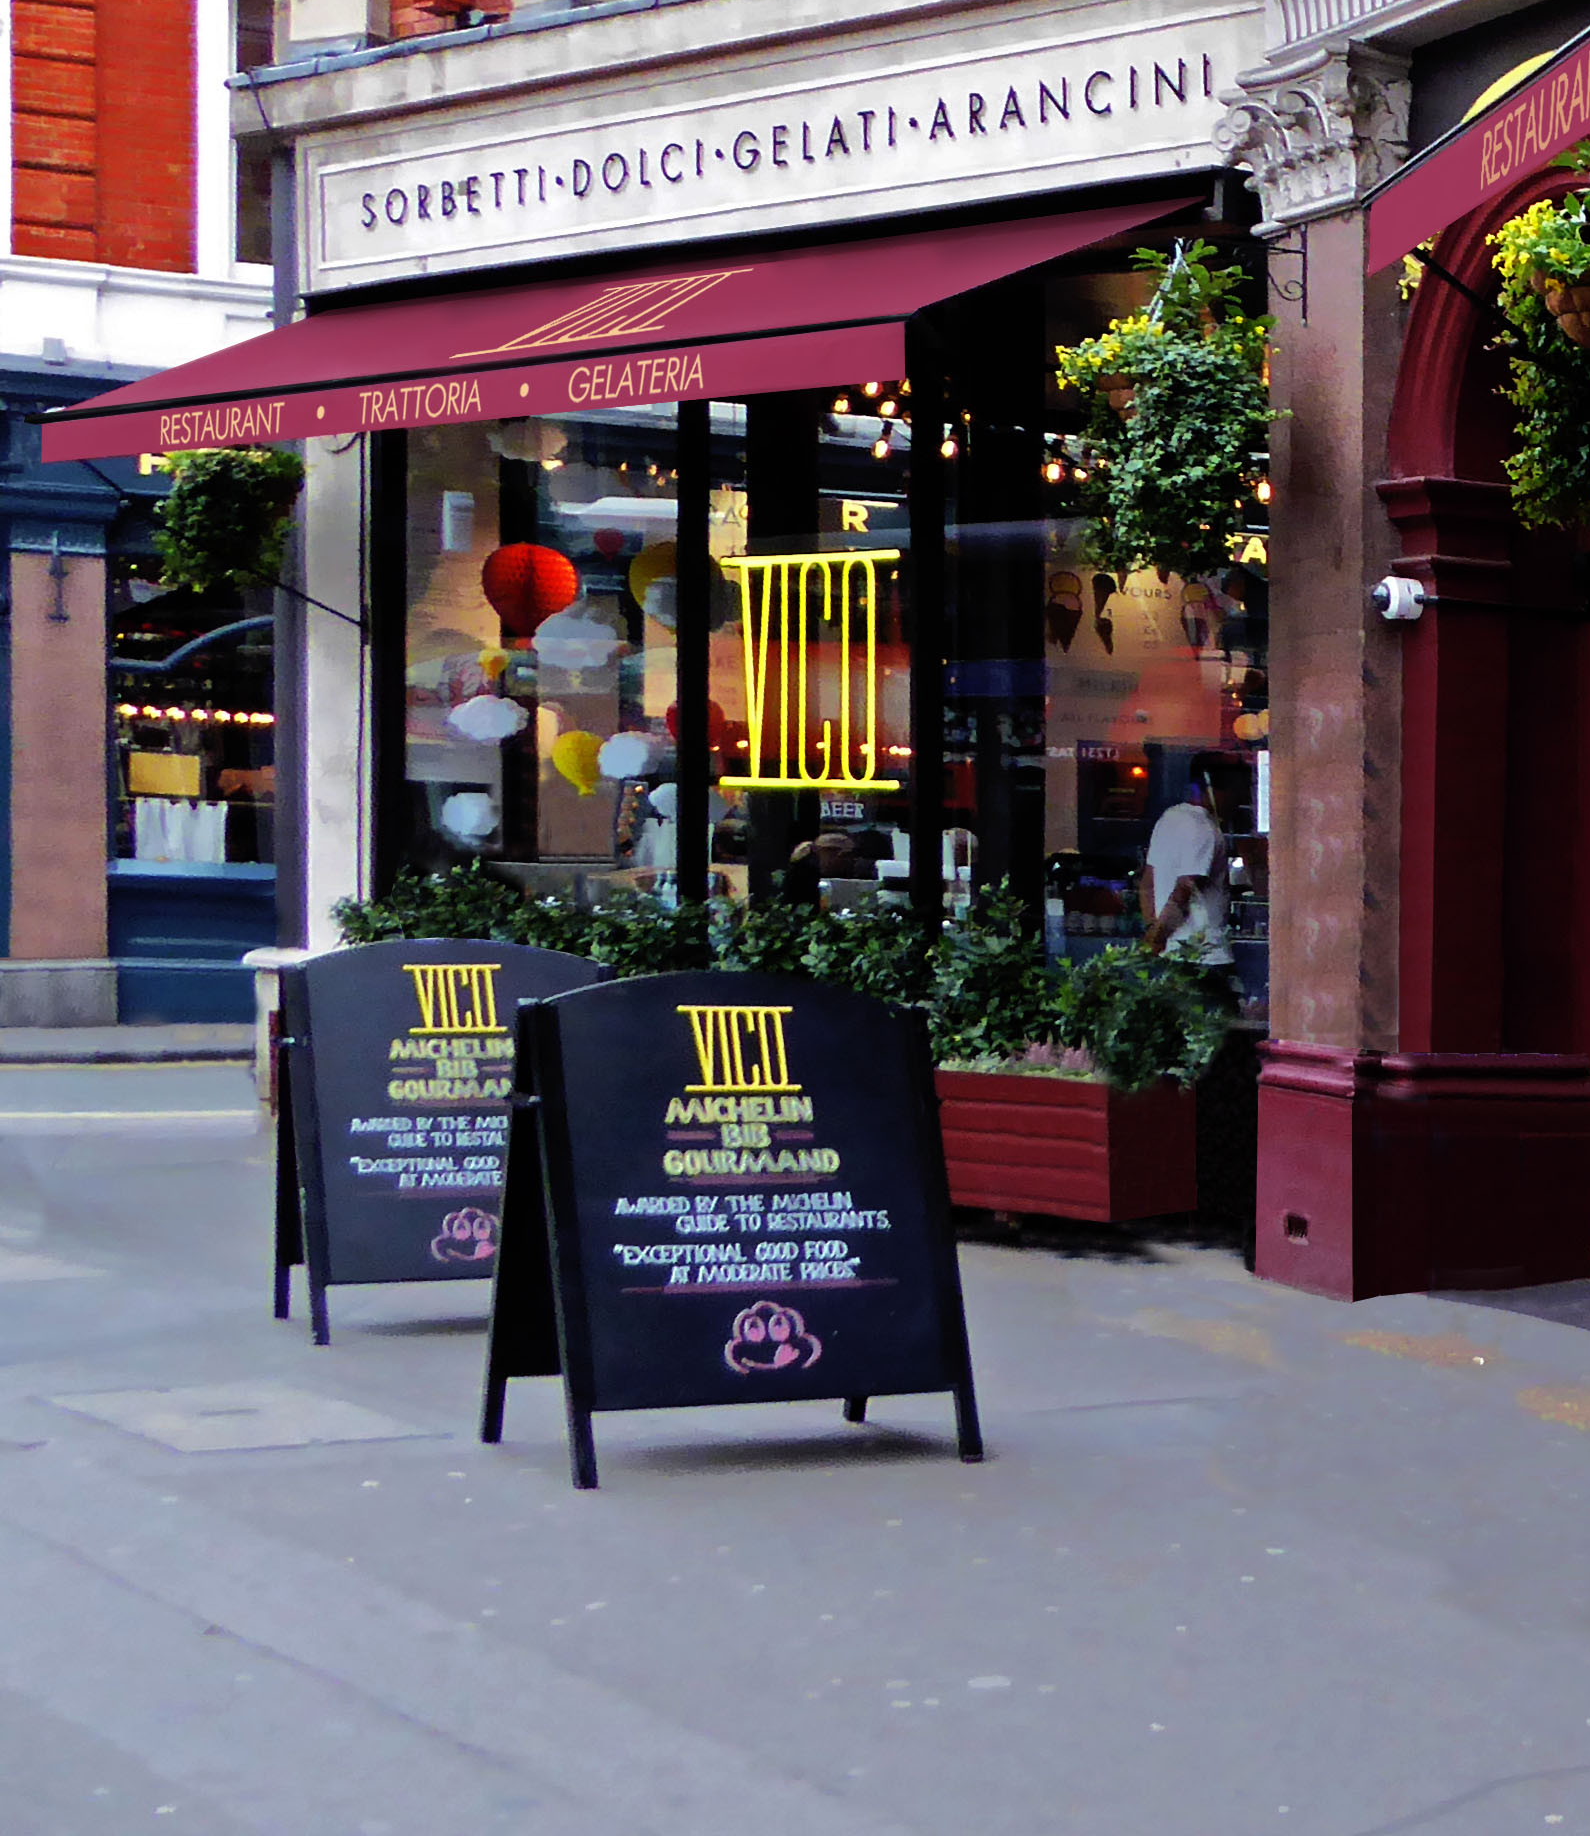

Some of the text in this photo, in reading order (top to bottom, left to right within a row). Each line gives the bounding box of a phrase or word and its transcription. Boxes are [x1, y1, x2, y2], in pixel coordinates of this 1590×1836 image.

[160, 353, 704, 446] RESTAURANT TRATTORIA GELATERIA
[719, 548, 901, 791] VICO
[403, 963, 508, 1035] VICO
[388, 1037, 516, 1061] MICHELIN
[676, 1004, 803, 1094] VICO
[435, 1058, 479, 1080] BIB
[664, 1096, 814, 1125] MICHELIN
[437, 1115, 472, 1131] THE
[720, 1121, 772, 1149] BIB
[431, 1131, 453, 1147] TO
[463, 1155, 501, 1170] GOOD
[662, 1147, 841, 1176] GOURMAND
[614, 1190, 853, 1215] AWARDED BY THE MICHELIN
[676, 1214, 730, 1234] GUIDE
[733, 1213, 761, 1233] TO
[755, 1241, 799, 1261] GOOD
[804, 1239, 849, 1260] FOOD
[669, 1265, 690, 1285] AT
[697, 1262, 794, 1283] MODERATE
